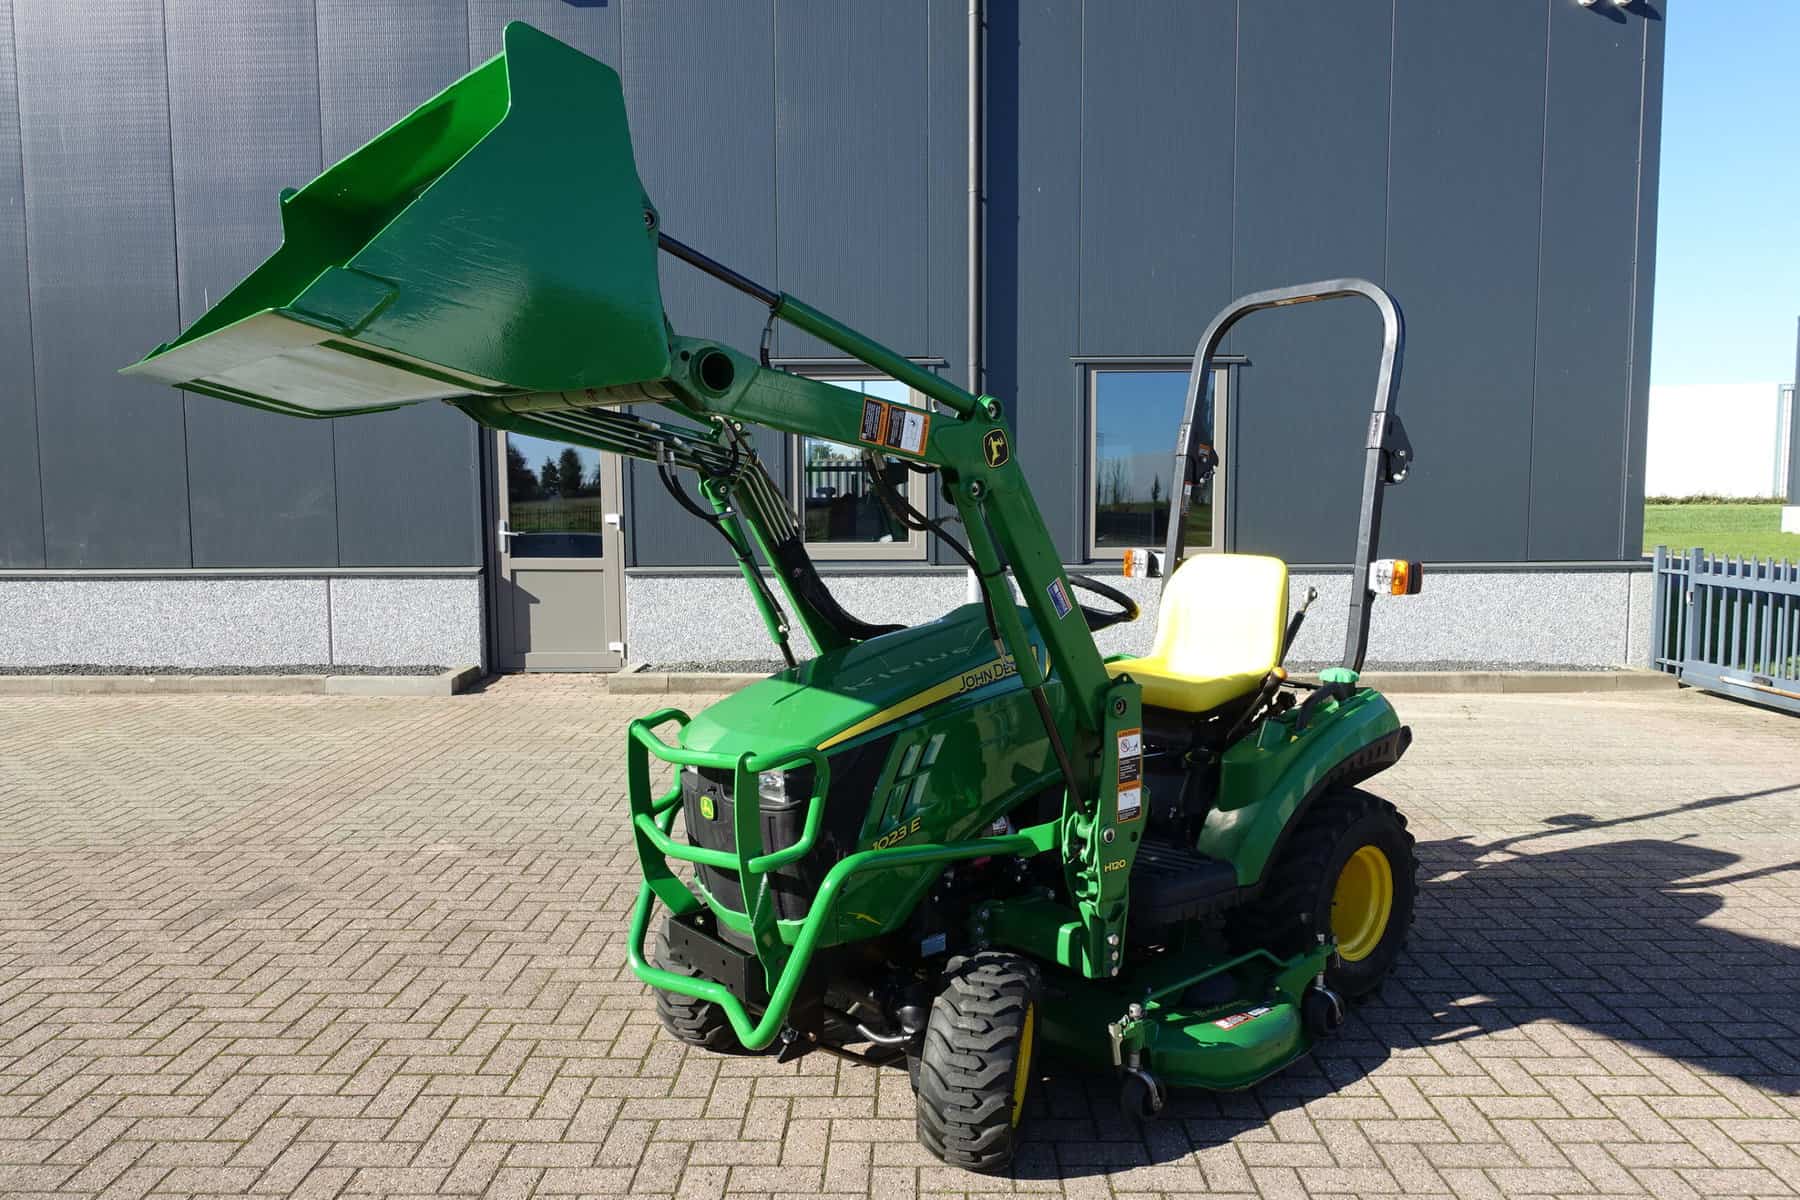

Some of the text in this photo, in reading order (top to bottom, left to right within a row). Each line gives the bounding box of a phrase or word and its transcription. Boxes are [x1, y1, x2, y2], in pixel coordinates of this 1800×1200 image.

[959, 670, 992, 691] JOHN
[872, 816, 921, 851] 1023 E
[1104, 859, 1127, 872] H120
